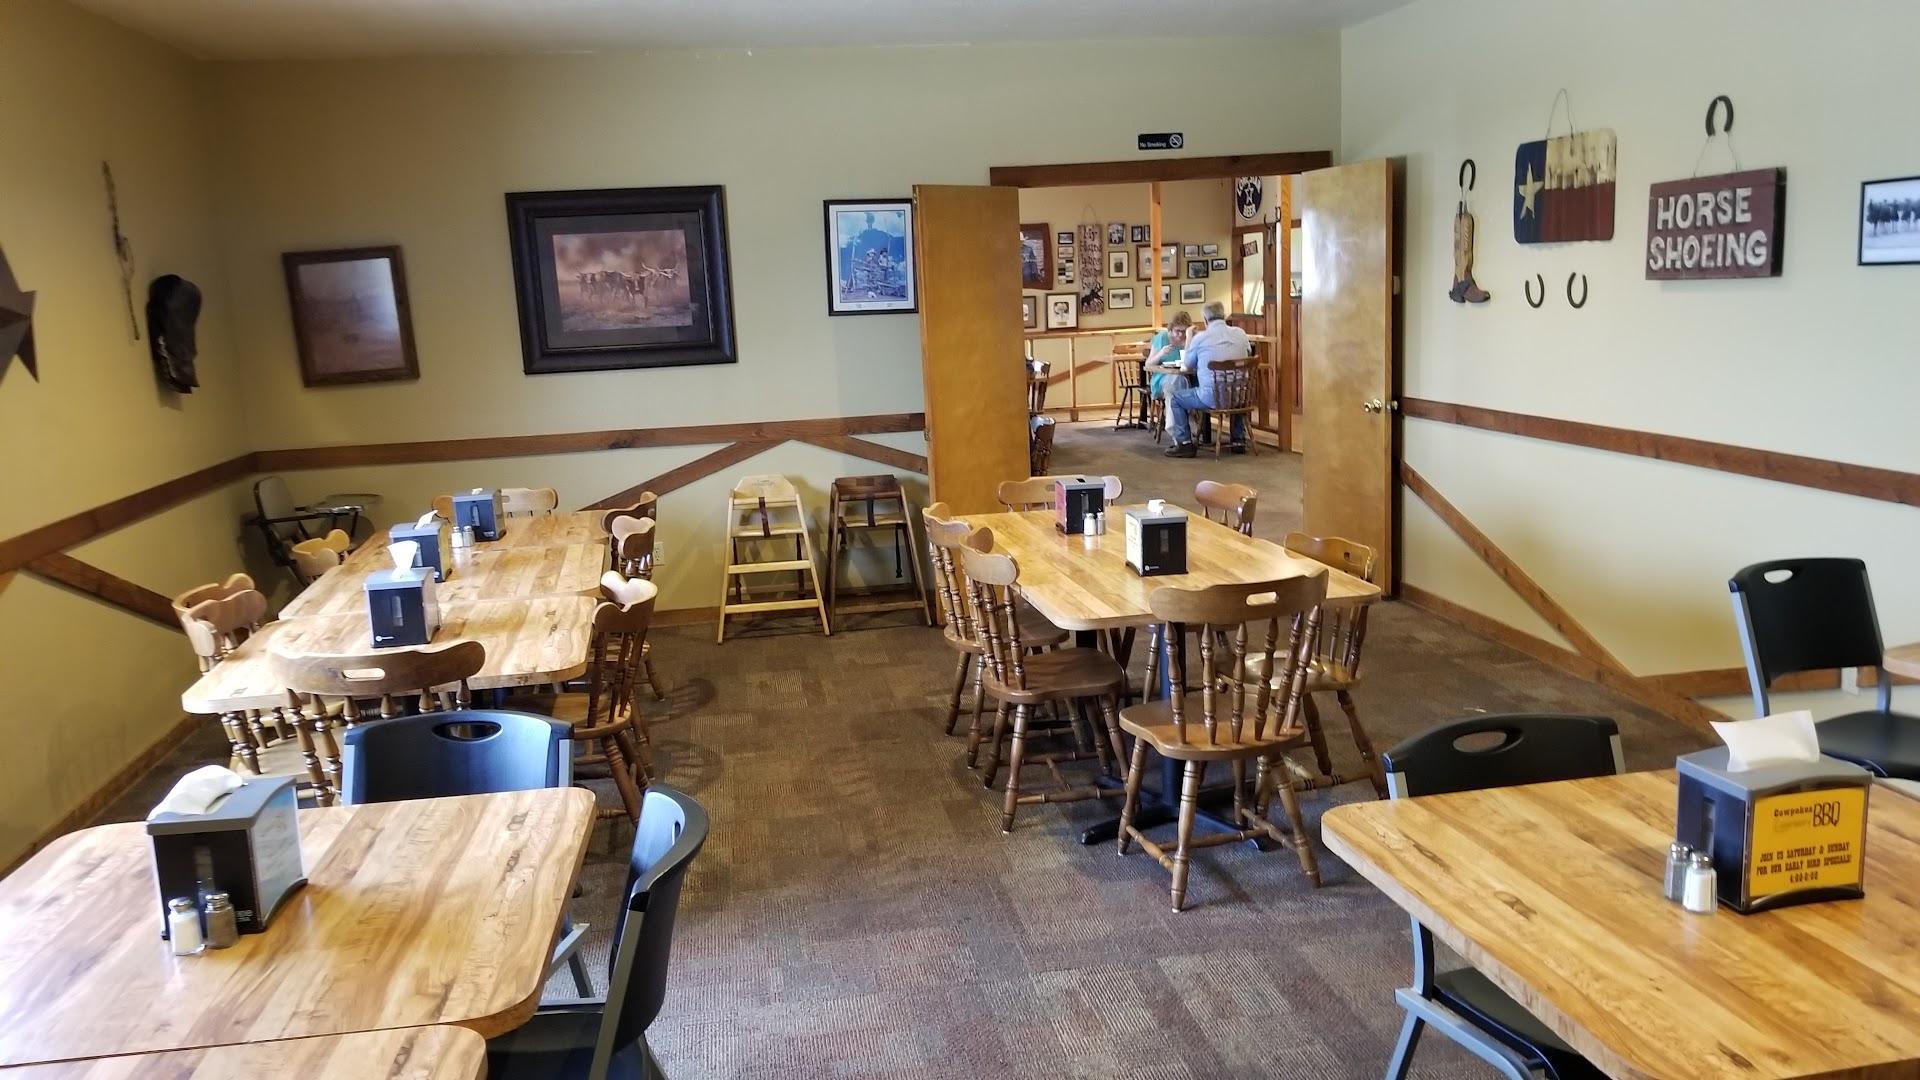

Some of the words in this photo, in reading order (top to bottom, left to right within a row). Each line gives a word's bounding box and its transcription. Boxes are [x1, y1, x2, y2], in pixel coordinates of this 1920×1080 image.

[1657, 187, 1752, 230] HORSE
[1649, 229, 1768, 271] SHOEING
[1813, 801, 1840, 826] BBQ
[1760, 852, 1773, 862] JOIN
[1777, 850, 1783, 859] US
[1787, 846, 1816, 858] SATURDAY
[1828, 842, 1849, 853] SUNDAY
[1757, 865, 1767, 875] FOR
[1771, 863, 1781, 873] OUR
[1785, 860, 1803, 871] EARLY
[1807, 858, 1820, 868] BIRD
